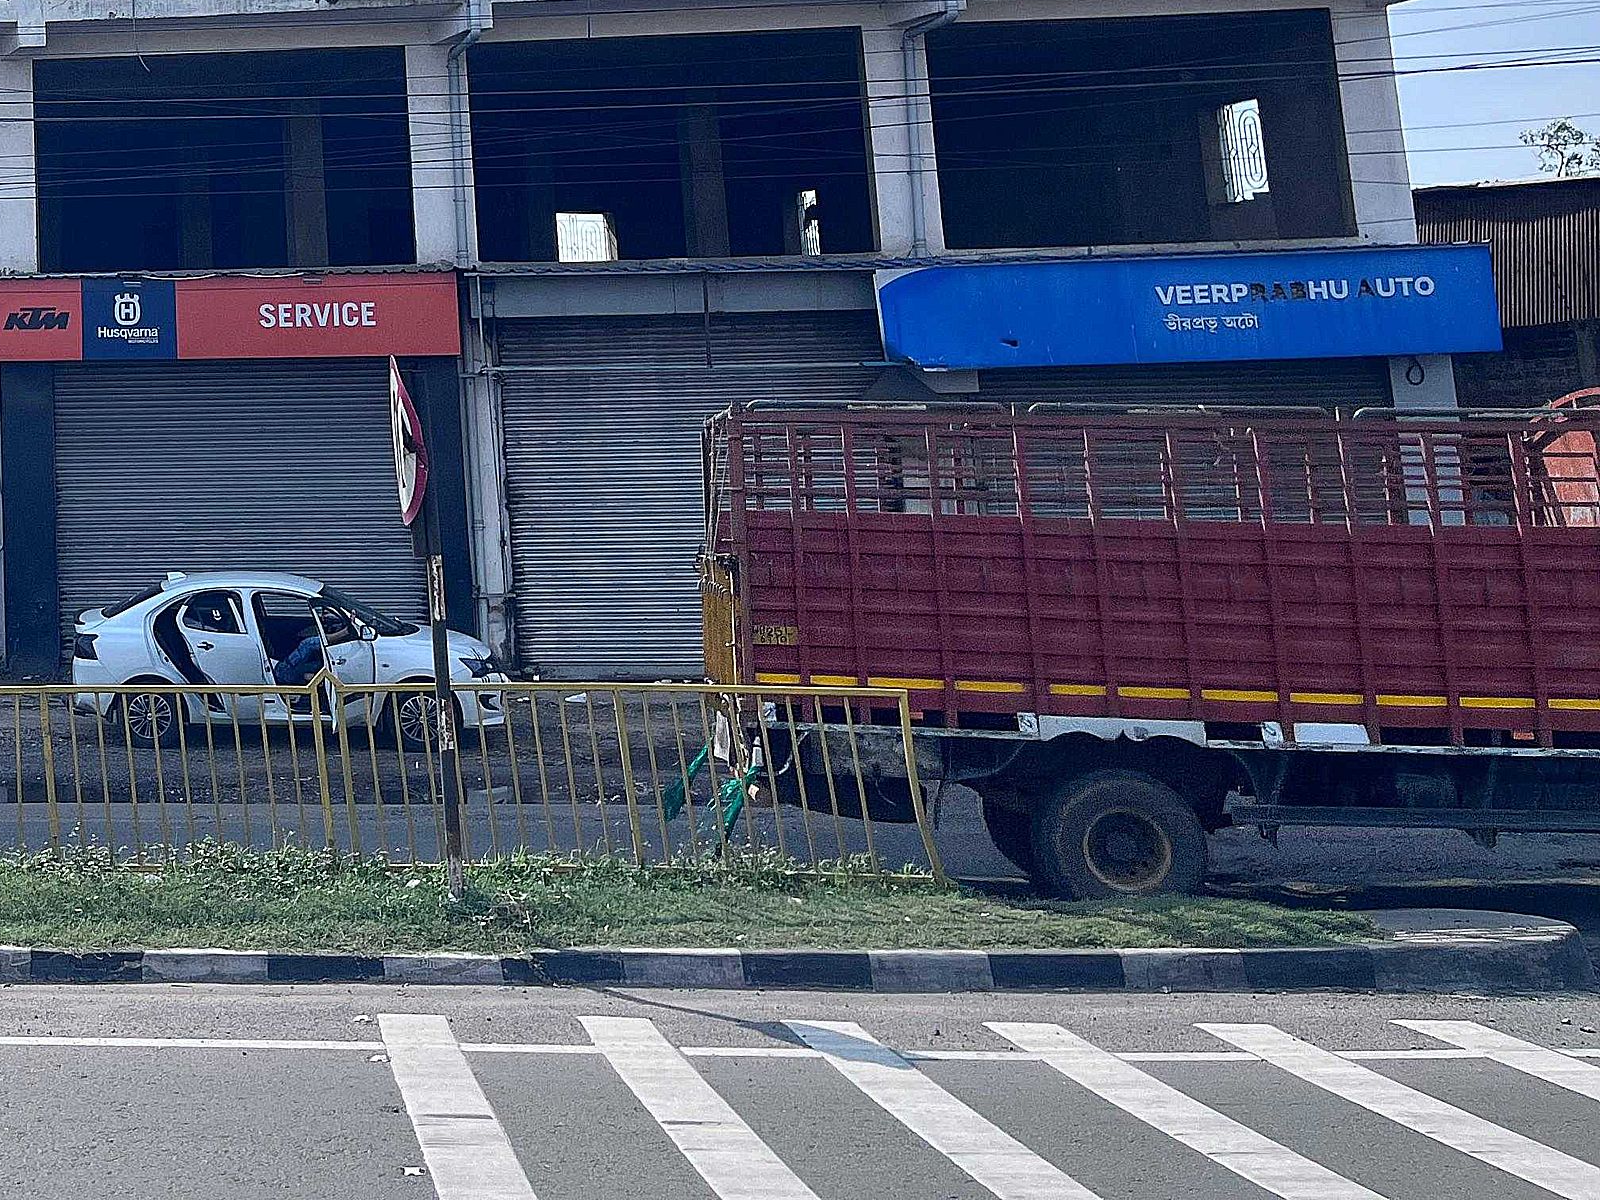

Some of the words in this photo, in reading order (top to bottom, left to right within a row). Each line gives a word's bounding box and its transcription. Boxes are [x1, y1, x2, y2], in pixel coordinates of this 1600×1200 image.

[1358, 276, 1435, 298] AUTO
[3, 307, 70, 330] KTM
[259, 301, 377, 328] SERVICE
[97, 326, 159, 340] Husqvarna
